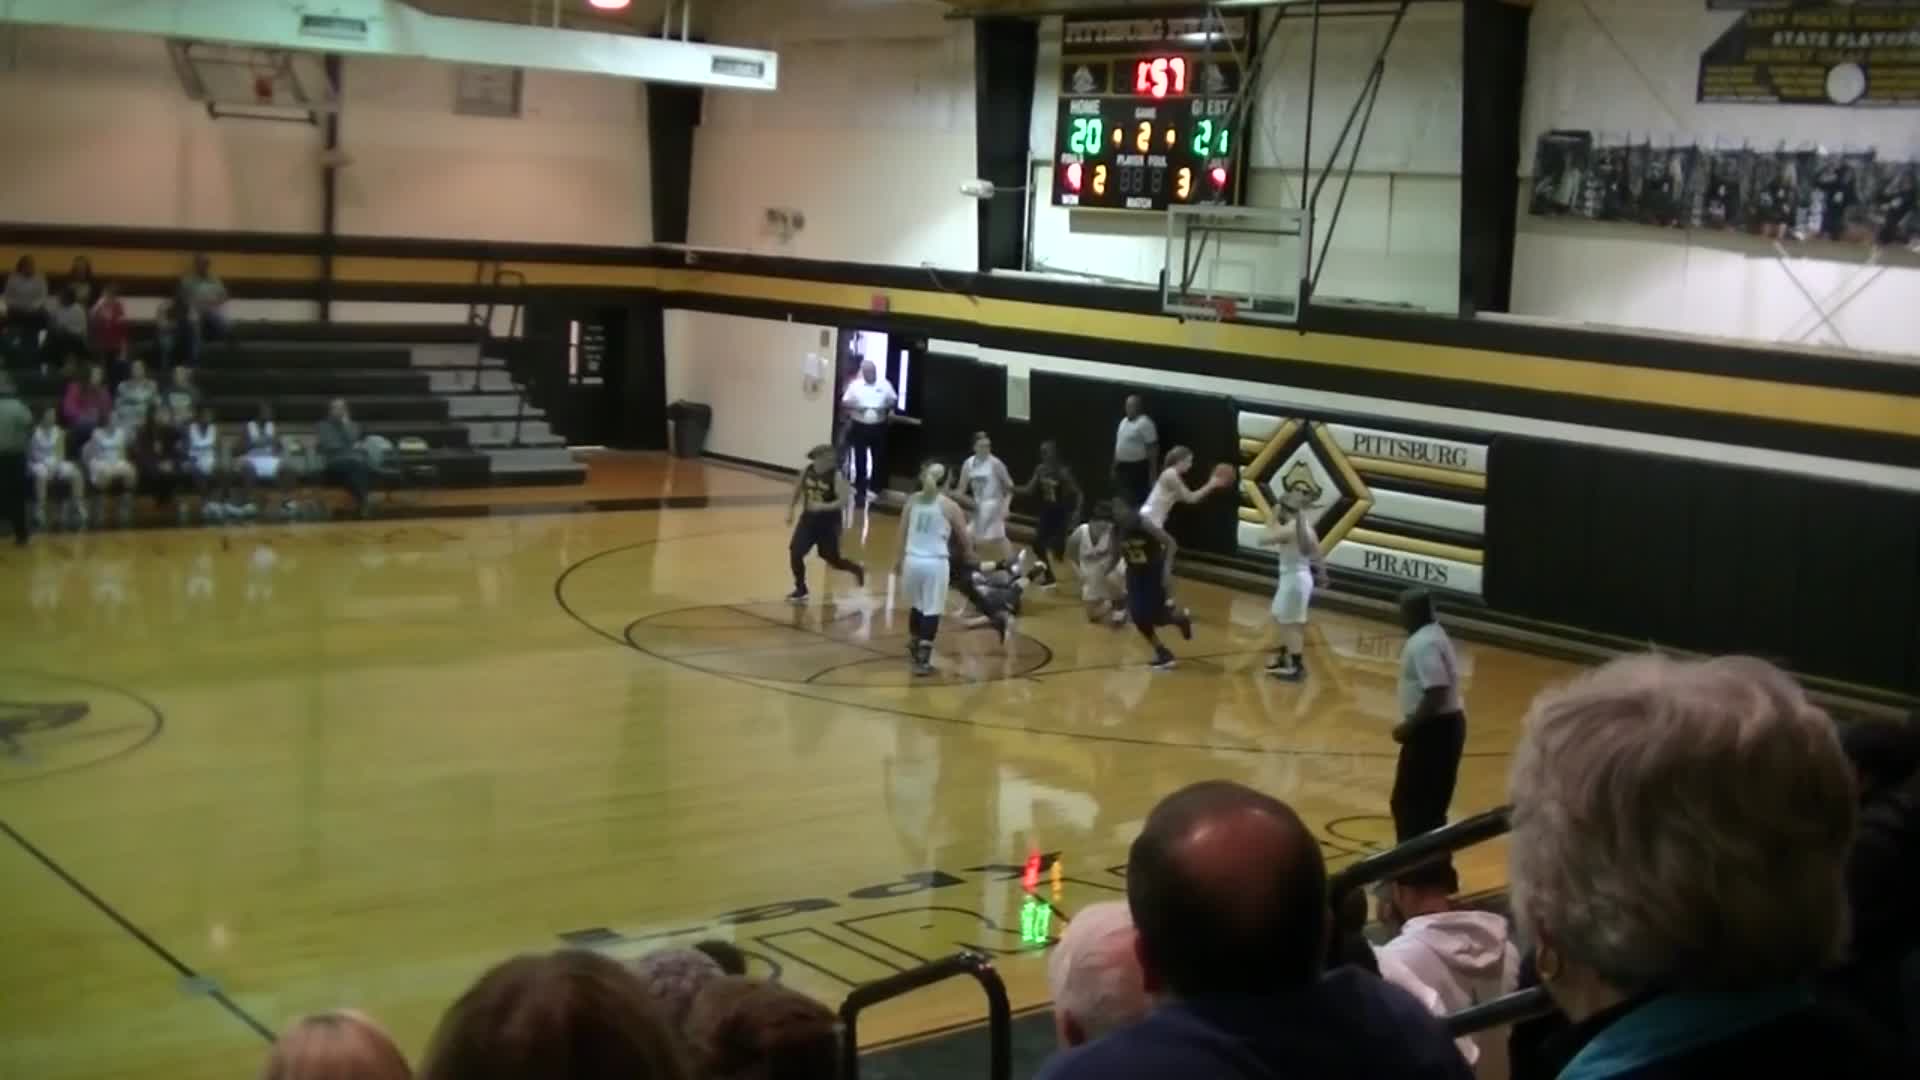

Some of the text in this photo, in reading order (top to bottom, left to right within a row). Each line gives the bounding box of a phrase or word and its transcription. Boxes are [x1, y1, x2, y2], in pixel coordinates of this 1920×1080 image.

[1772, 31, 1829, 48] STATE
[1192, 99, 1229, 115] GEST
[1071, 118, 1102, 154] 20
[1137, 121, 1151, 151] 2
[1194, 119, 1228, 156] 21
[1093, 164, 1107, 194] 2
[1177, 167, 1191, 199] 3
[1353, 433, 1468, 467] PITTSBURG
[1364, 551, 1449, 583] PIRATES
